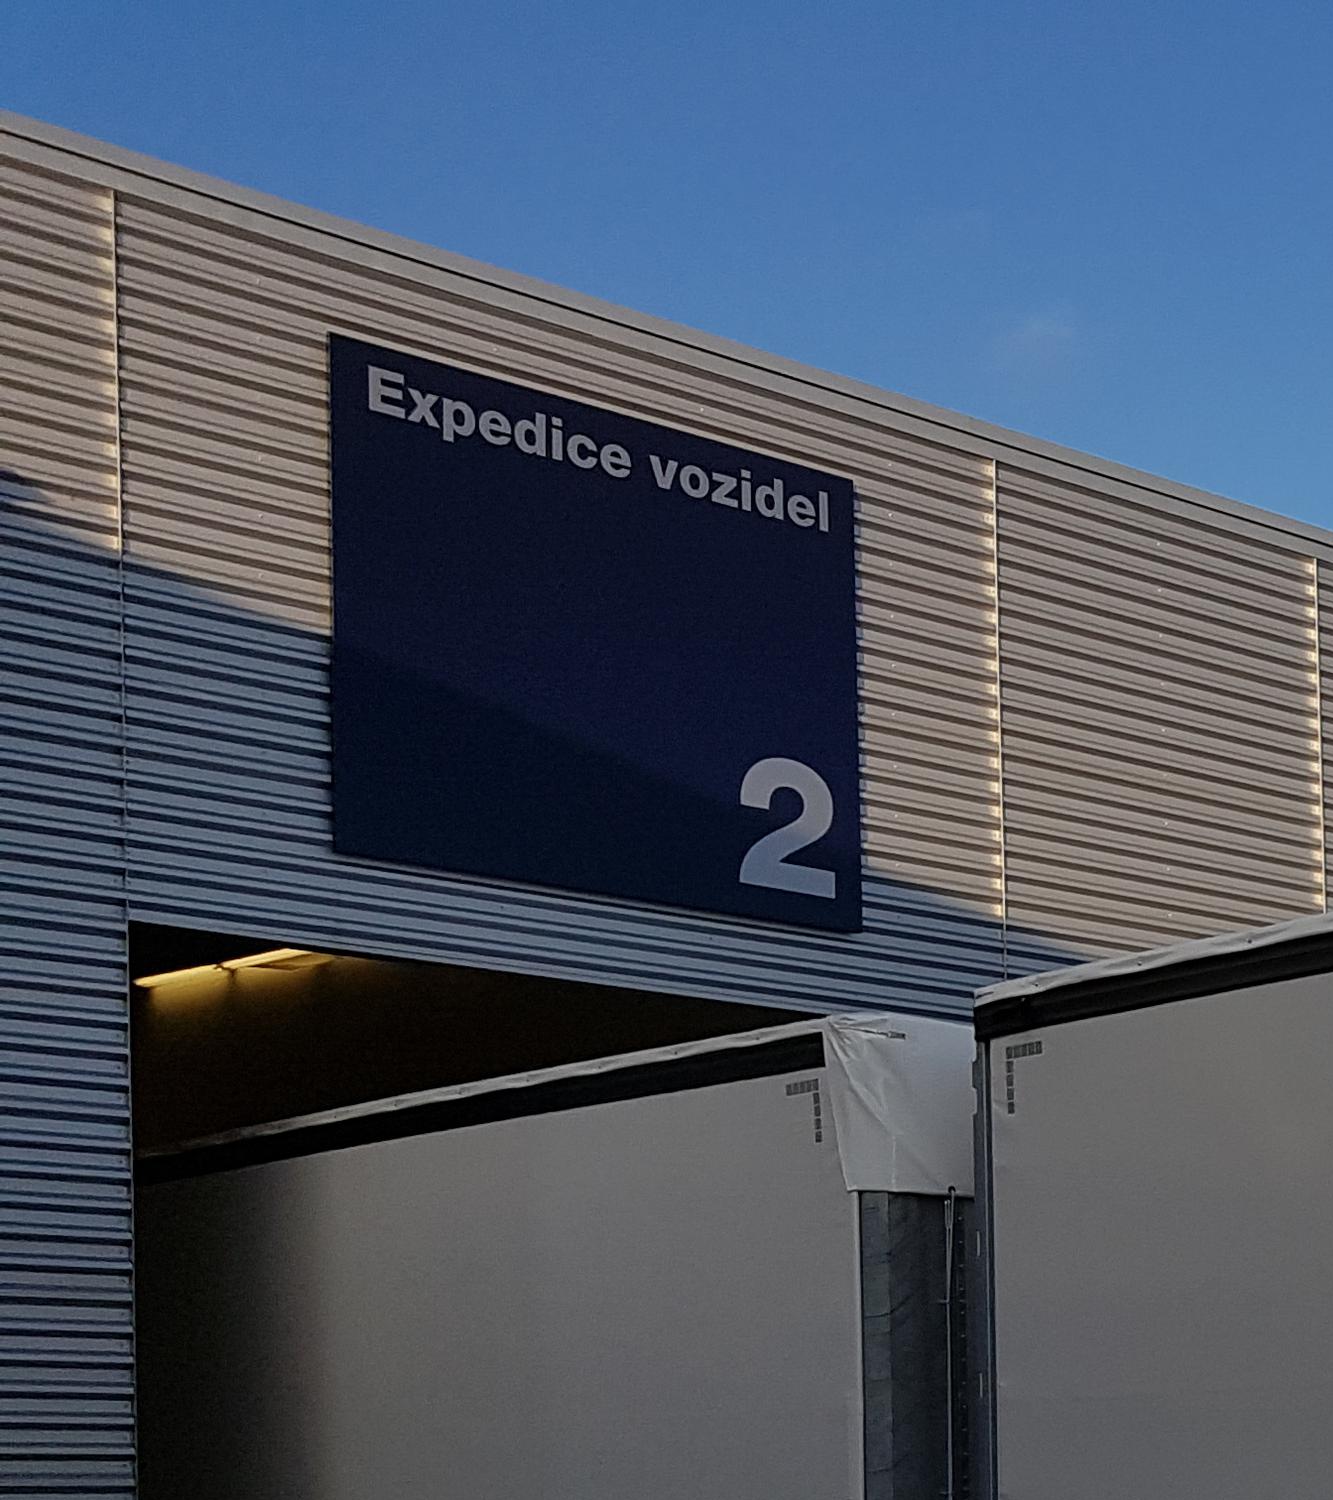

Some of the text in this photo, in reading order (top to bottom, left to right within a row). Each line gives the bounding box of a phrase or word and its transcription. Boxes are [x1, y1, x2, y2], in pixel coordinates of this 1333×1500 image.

[367, 364, 832, 533] Expedice vozidel
[738, 757, 837, 900] 2
